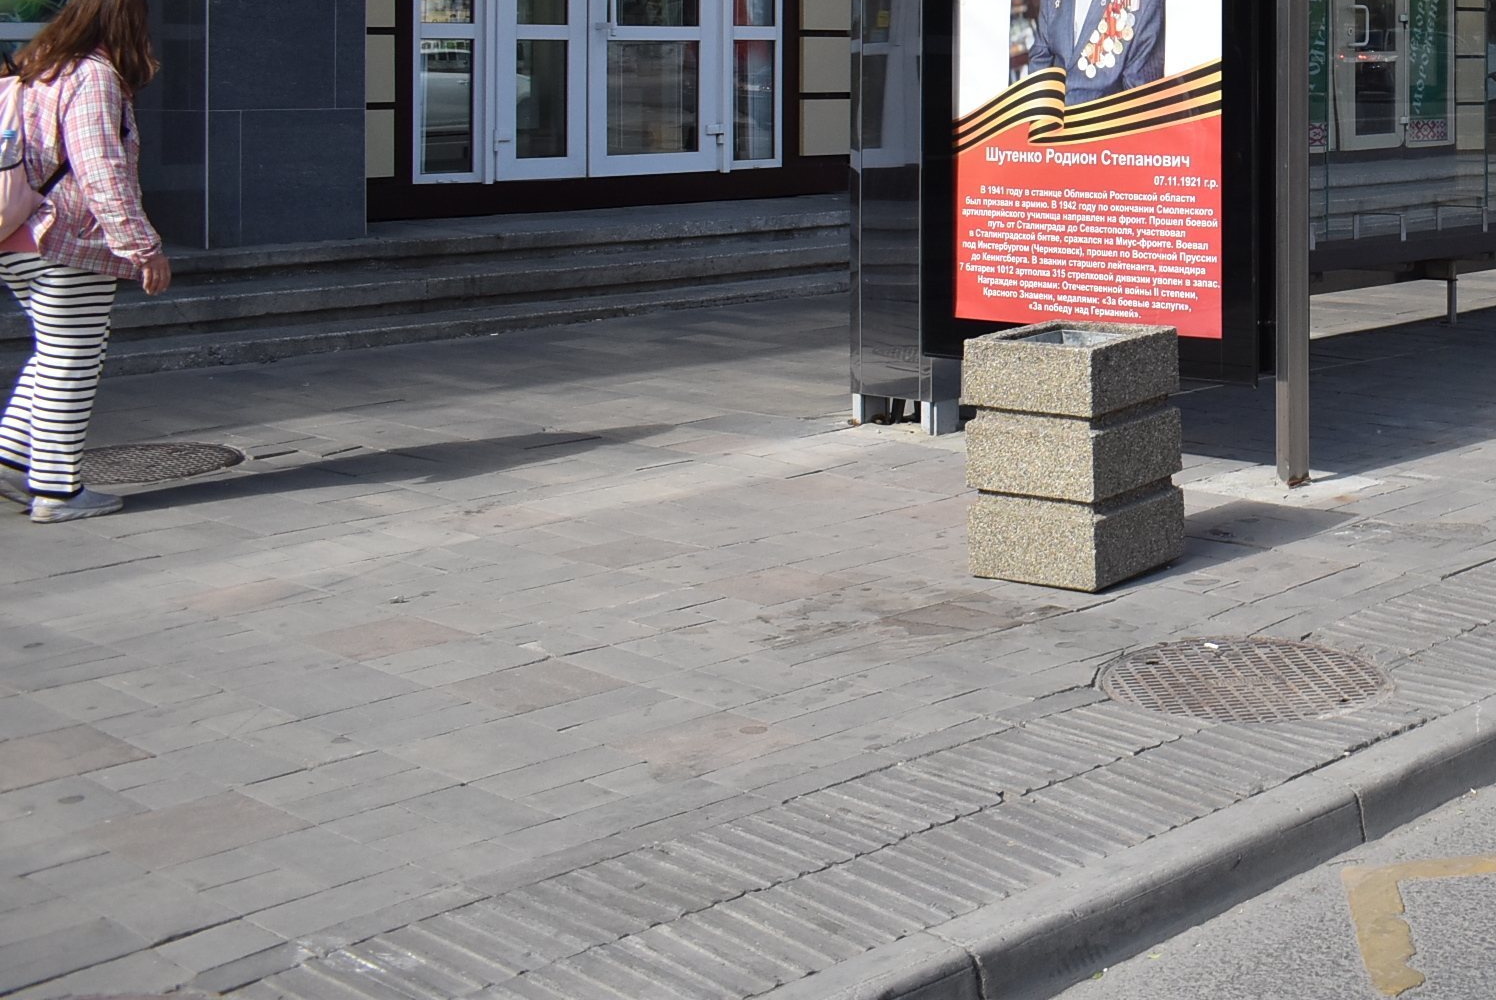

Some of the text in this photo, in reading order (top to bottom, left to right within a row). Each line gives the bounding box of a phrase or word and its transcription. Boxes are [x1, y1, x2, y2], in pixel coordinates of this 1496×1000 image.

[986, 147, 1190, 167] Шутенко Родион Степанович
[1154, 176, 1218, 189] 07.11.1921 г.р.
[988, 186, 1004, 194] 1941
[1059, 201, 1077, 210] 1942
[997, 265, 1014, 274] 1012
[1052, 269, 1066, 278] 315
